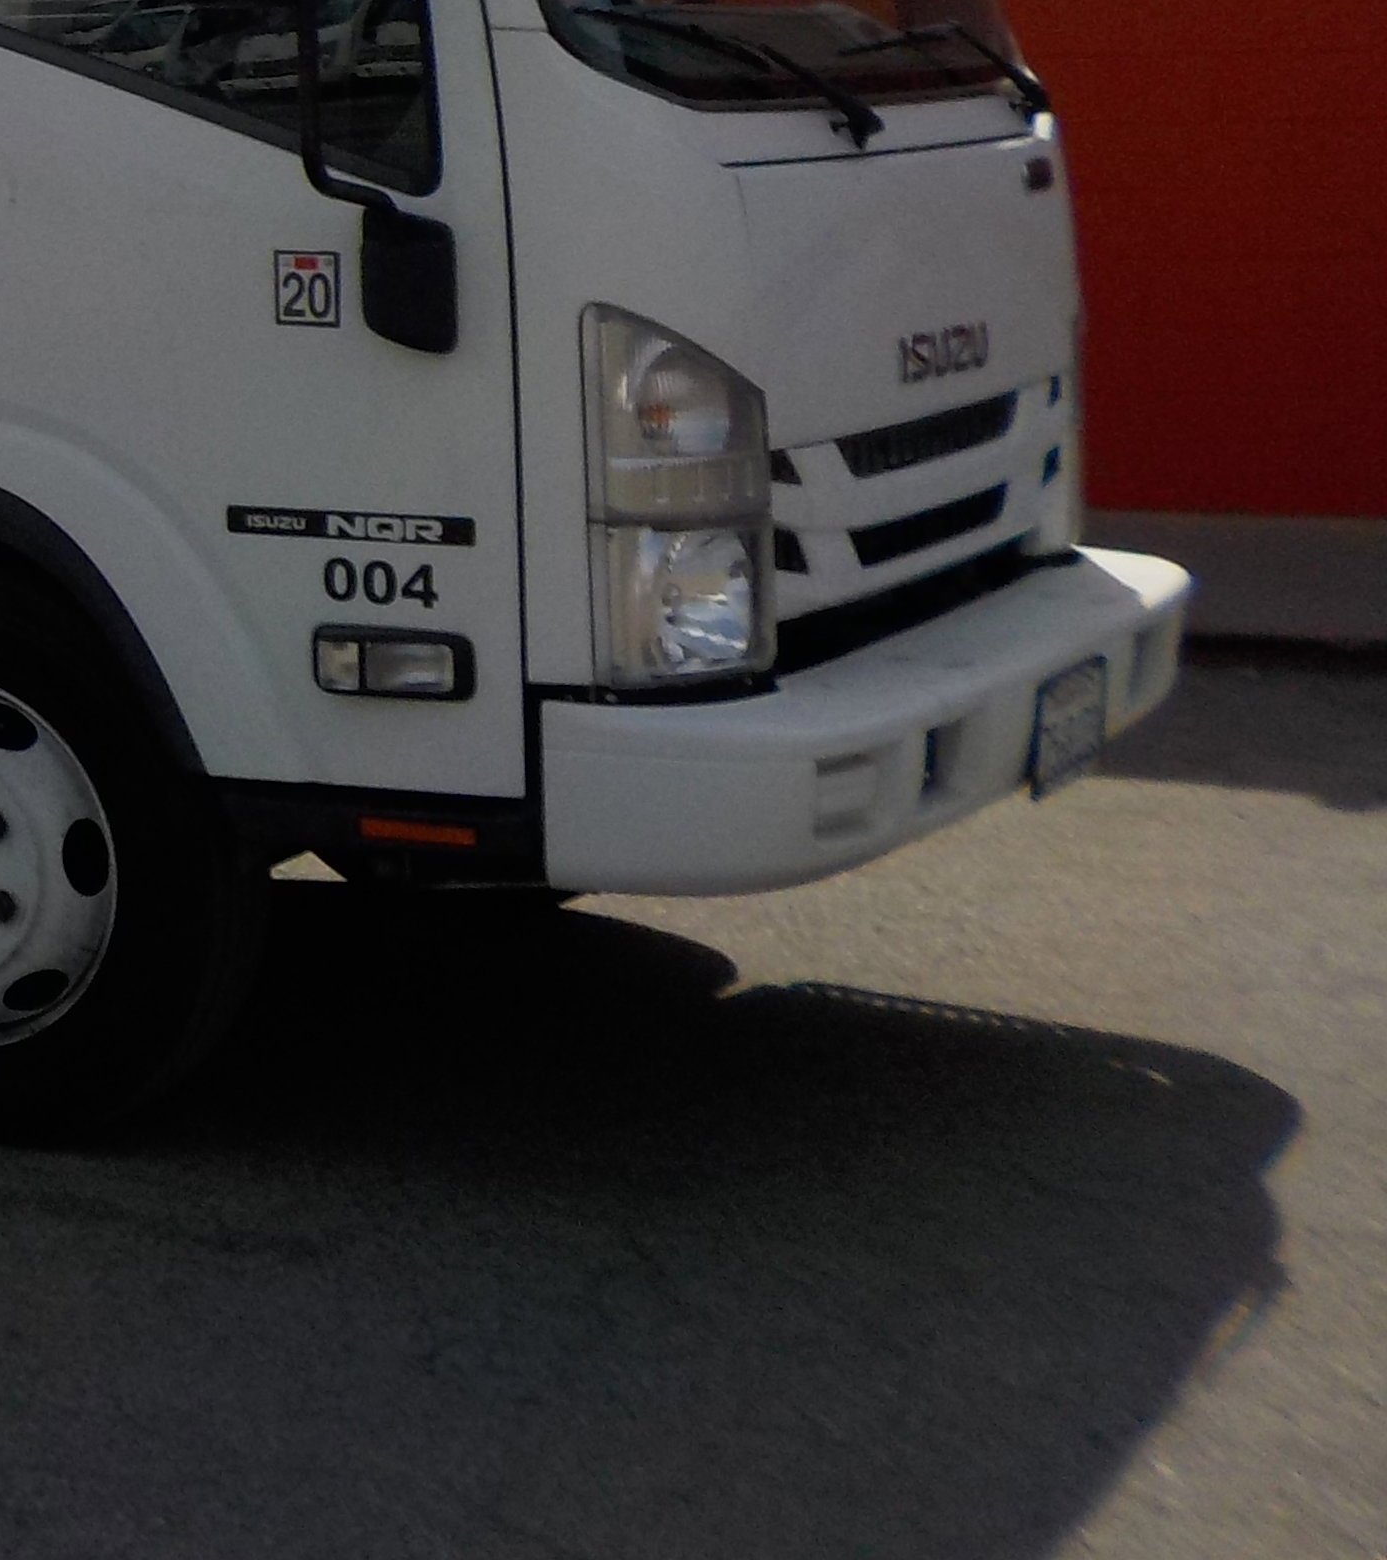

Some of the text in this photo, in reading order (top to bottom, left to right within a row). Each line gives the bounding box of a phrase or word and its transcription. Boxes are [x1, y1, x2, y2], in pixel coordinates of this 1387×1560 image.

[283, 272, 331, 318] 20
[897, 321, 988, 383] ISUZU
[245, 513, 443, 542] ISUZU NQR
[324, 557, 439, 609] 004
